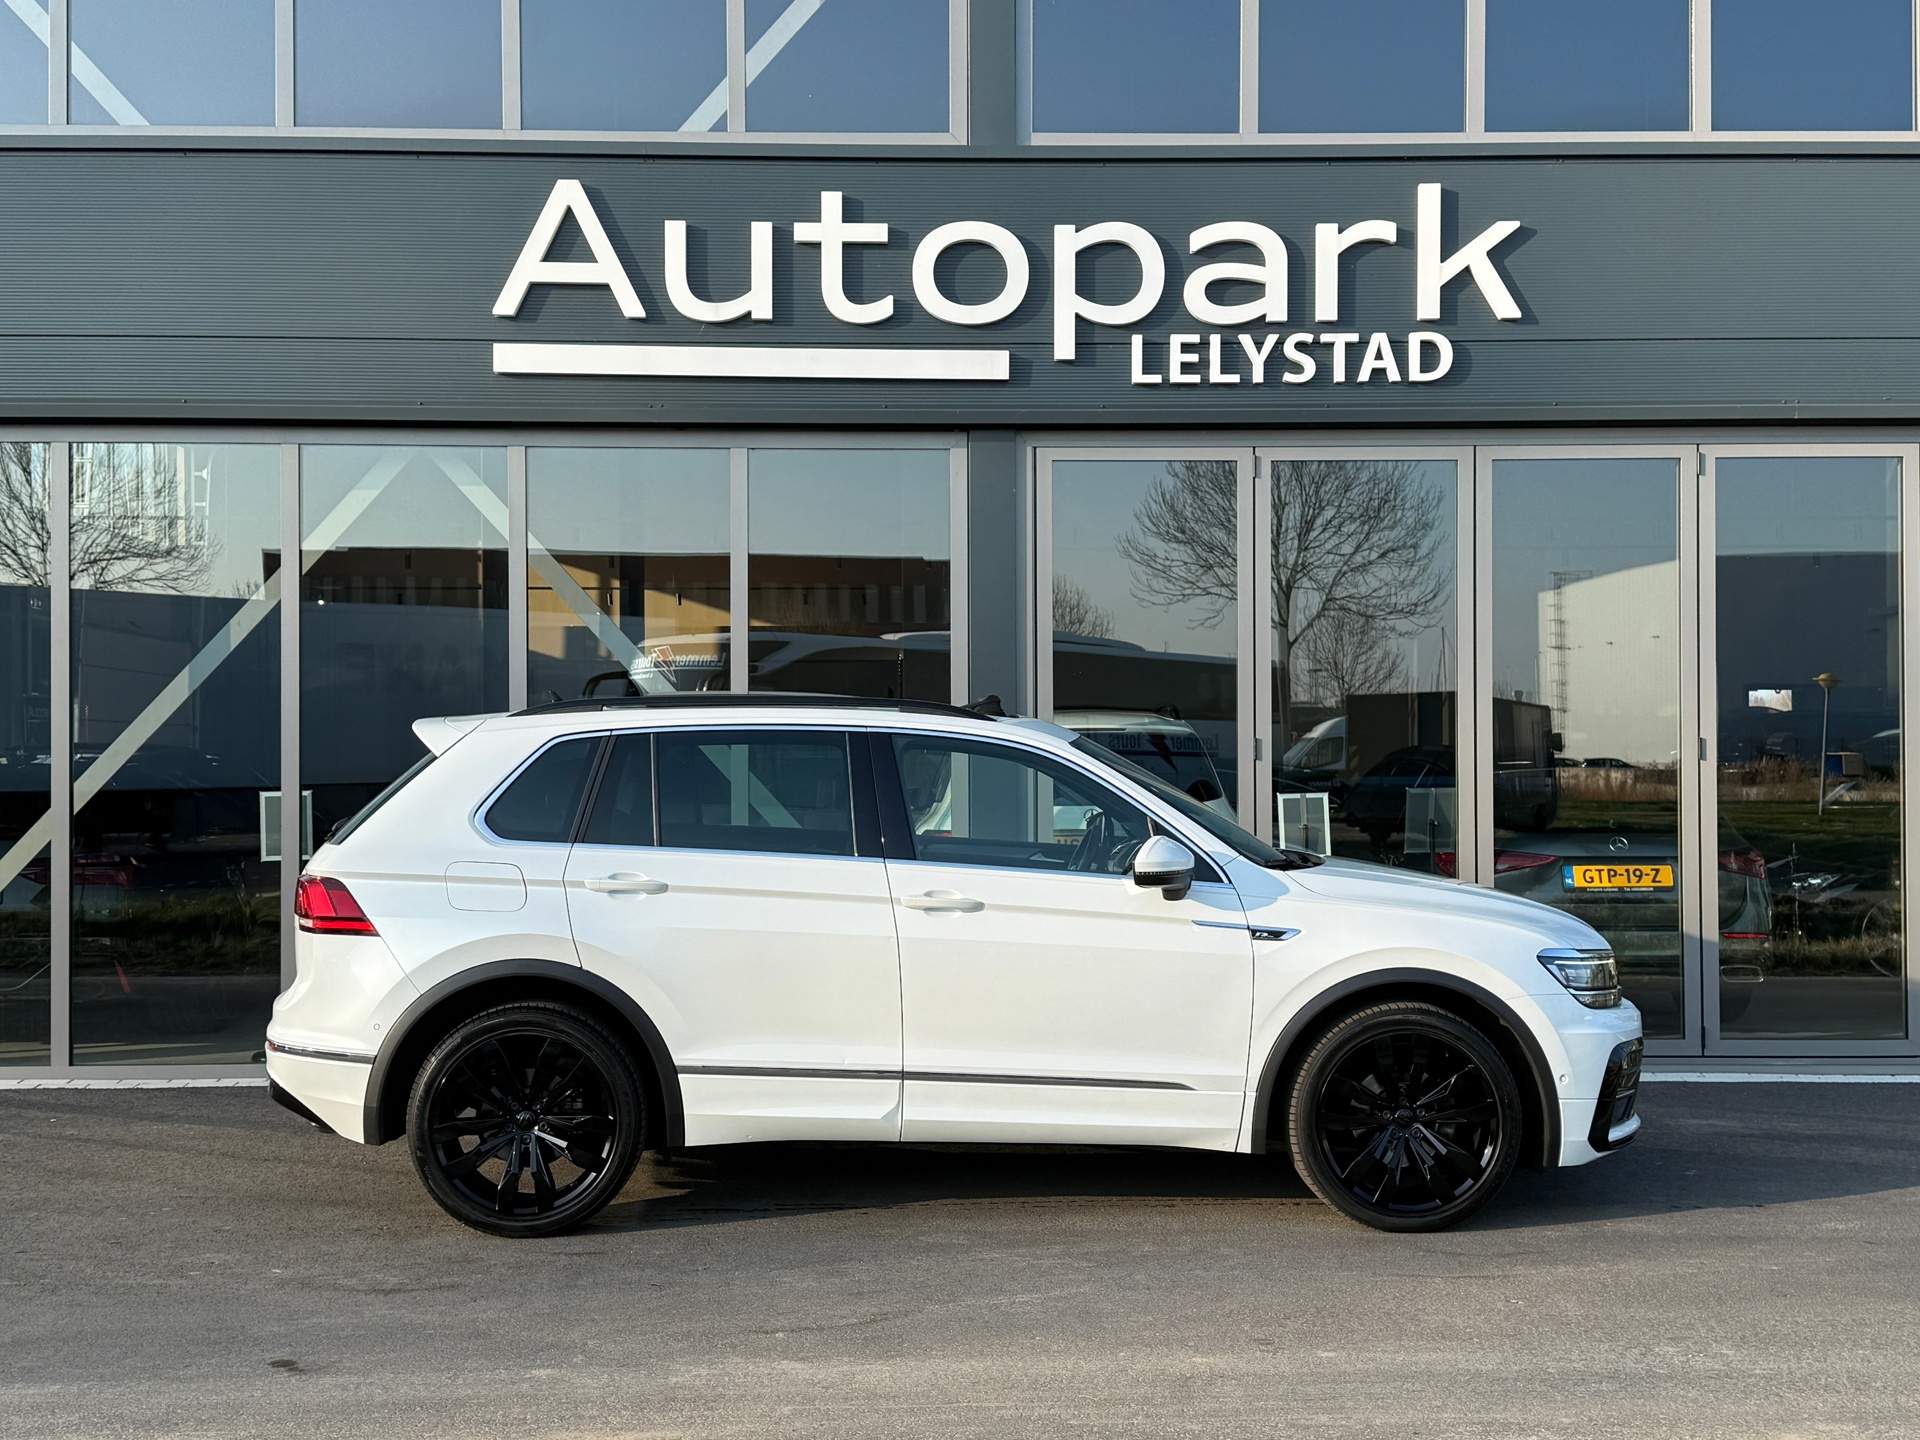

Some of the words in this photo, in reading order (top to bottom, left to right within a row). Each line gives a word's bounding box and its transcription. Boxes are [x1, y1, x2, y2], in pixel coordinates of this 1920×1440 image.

[492, 179, 1522, 361] Autopark
[1131, 331, 1454, 386] LELYSTAD
[1582, 867, 1663, 884] GTP-19-Z
